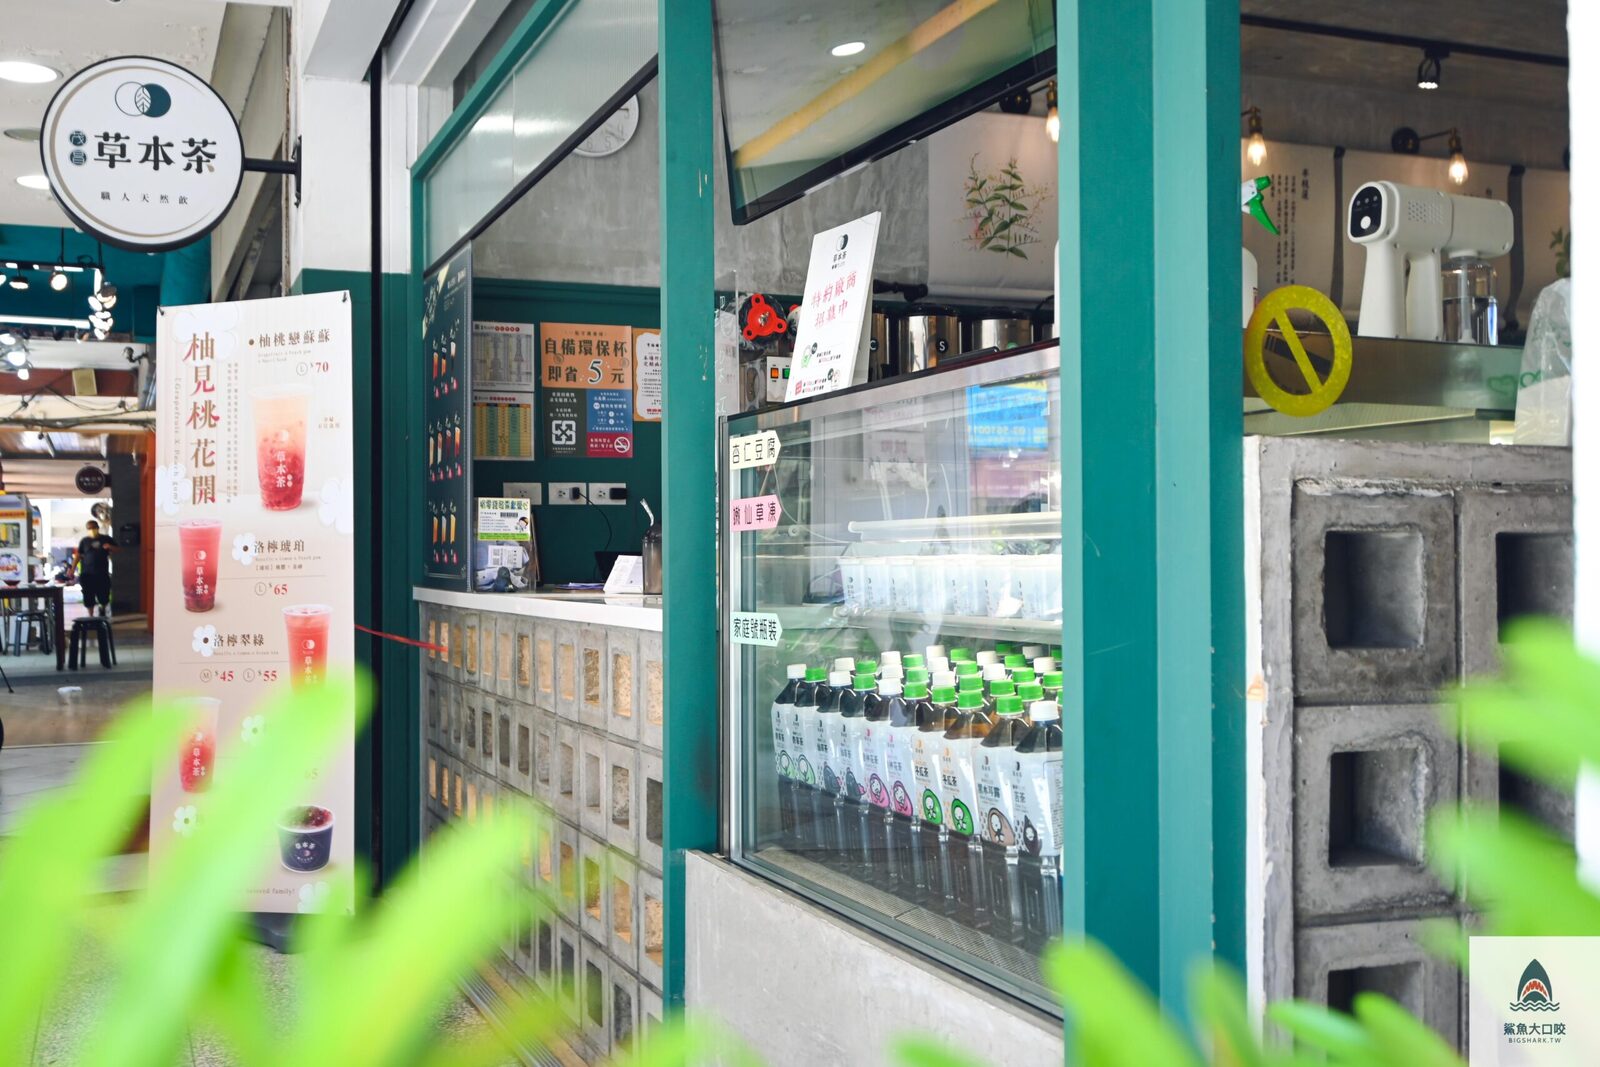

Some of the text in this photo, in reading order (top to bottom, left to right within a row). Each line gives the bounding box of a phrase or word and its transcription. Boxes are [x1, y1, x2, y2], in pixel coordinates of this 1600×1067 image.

[94, 132, 218, 174] 草本茶
[810, 271, 857, 308] 特約廠商
[259, 329, 330, 348] 柚桃戀蘇蘇
[544, 338, 628, 357] 自備環保杯
[939, 341, 946, 350] S
[548, 358, 624, 384] 即省5元
[183, 332, 220, 505] 柚見桃花開
[732, 438, 776, 464] 杏仁豆腐
[734, 618, 776, 640] 家庭號瓶裝
